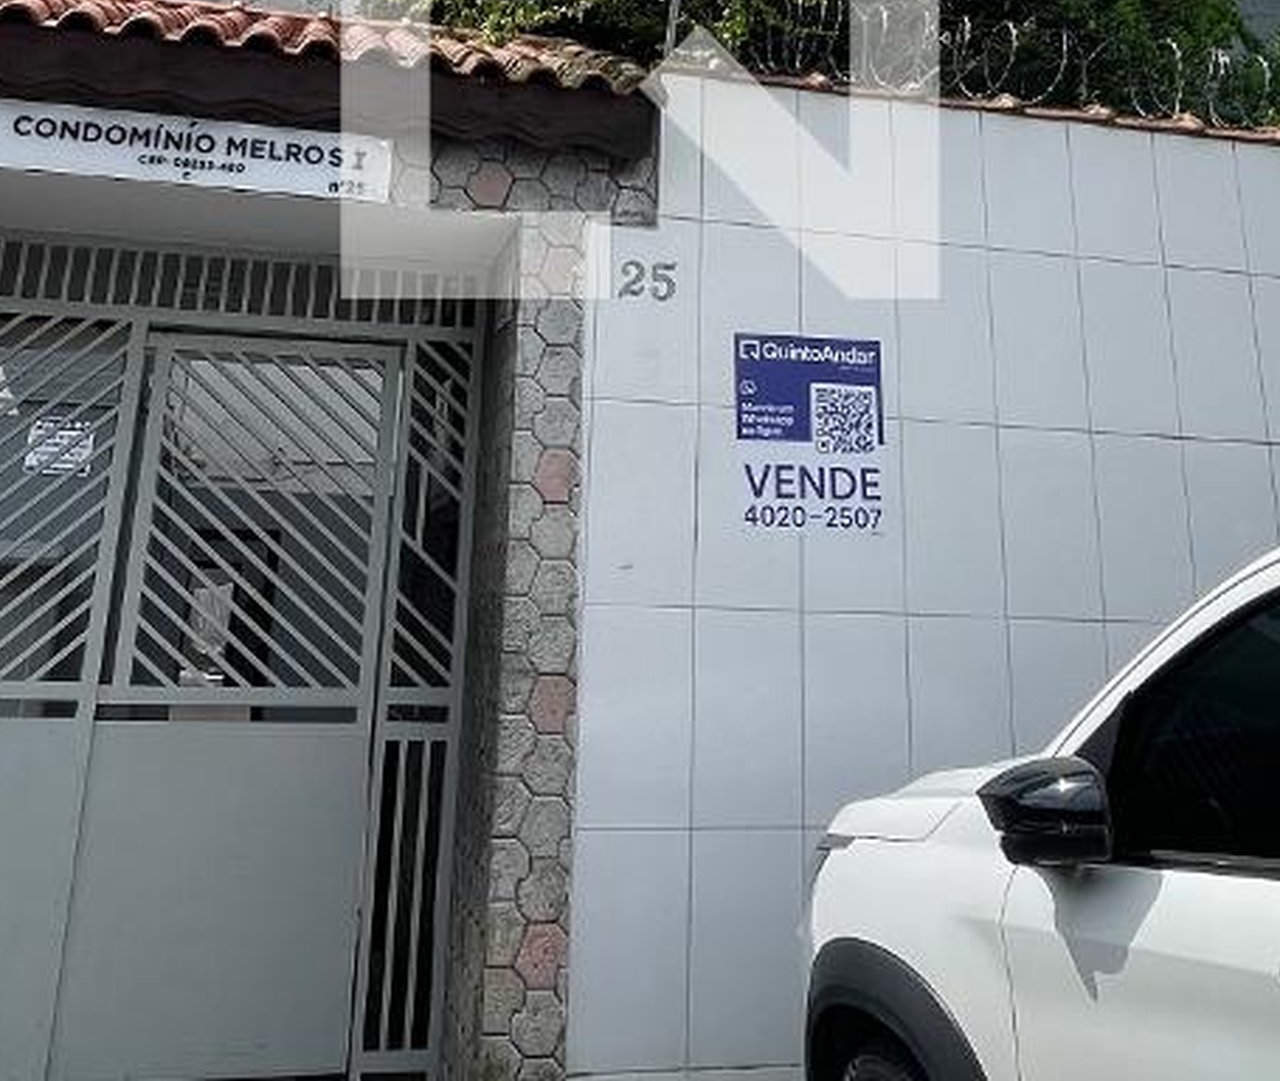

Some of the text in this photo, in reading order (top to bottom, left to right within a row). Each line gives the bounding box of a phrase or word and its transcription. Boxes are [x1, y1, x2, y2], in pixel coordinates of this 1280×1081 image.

[618, 260, 678, 302] 25
[743, 463, 883, 501] VENDE
[743, 504, 883, 530] 4020-2507
